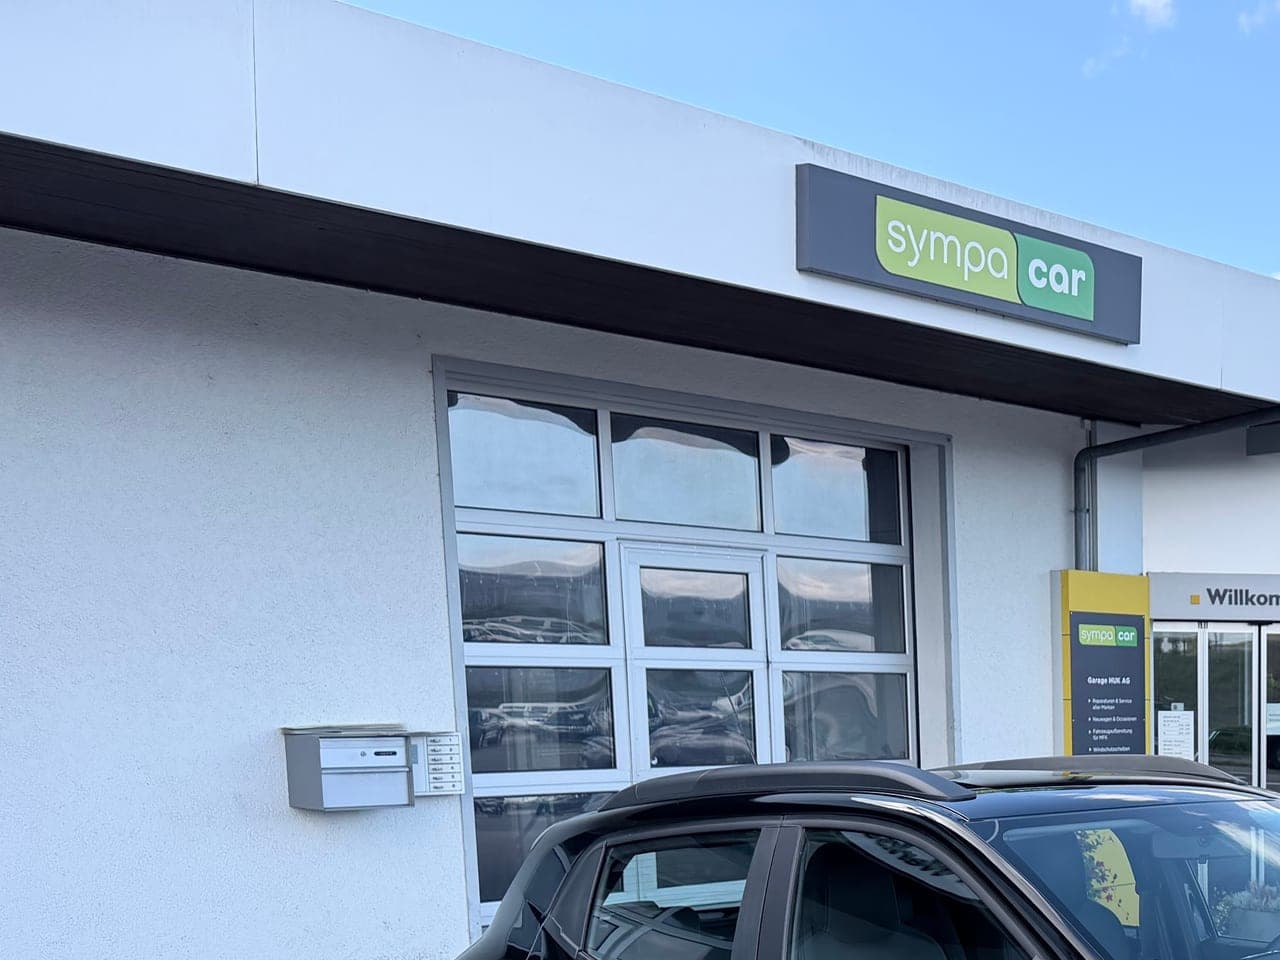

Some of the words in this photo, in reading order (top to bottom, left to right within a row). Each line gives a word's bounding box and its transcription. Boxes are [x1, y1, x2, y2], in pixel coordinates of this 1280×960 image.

[887, 219, 1008, 281] sympa
[1028, 258, 1086, 297] car
[1081, 629, 1113, 644] sympa
[1118, 631, 1135, 641] car
[1087, 676, 1108, 686] Garage
[1121, 677, 1131, 685] AG
